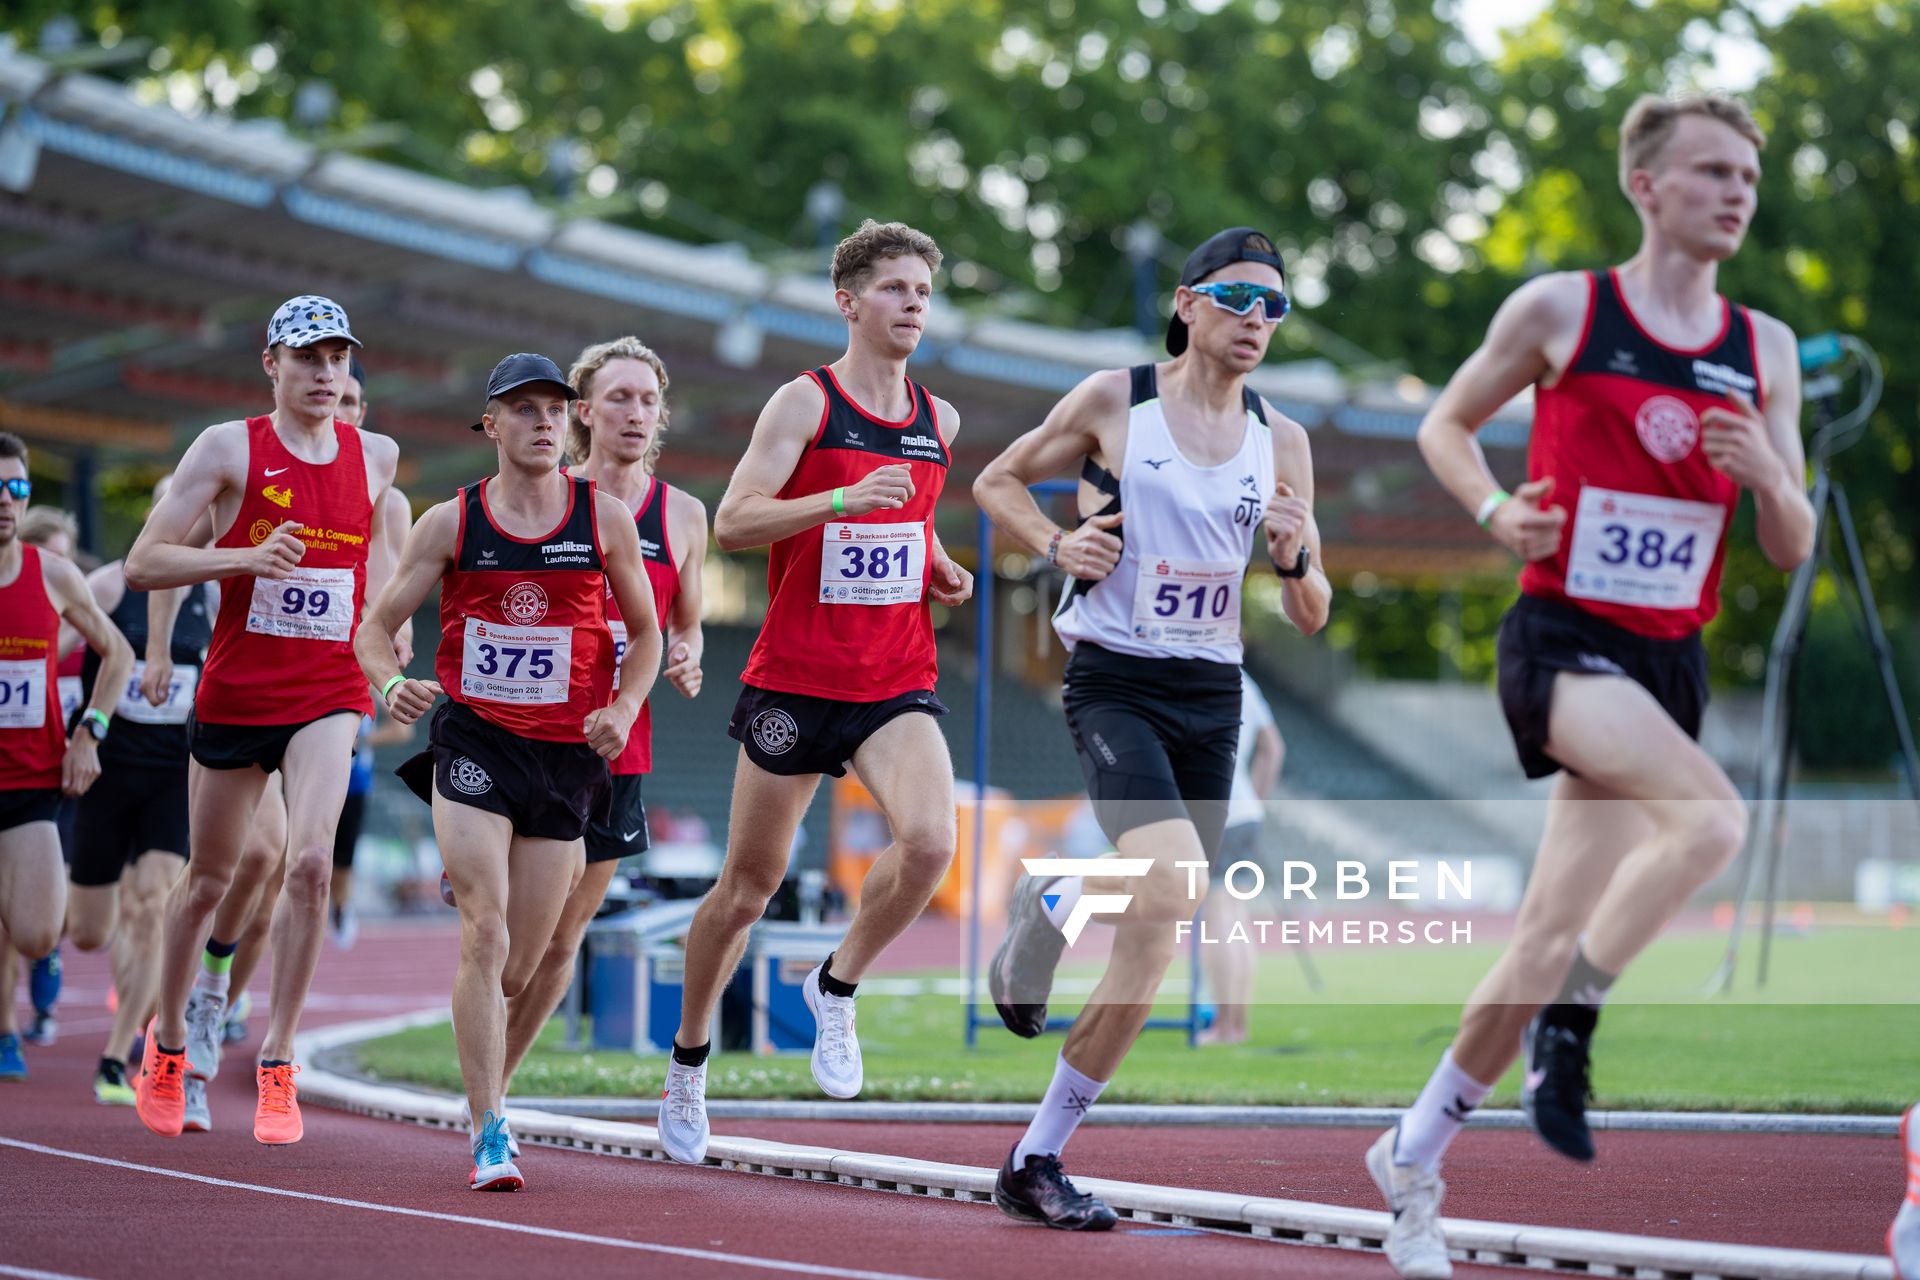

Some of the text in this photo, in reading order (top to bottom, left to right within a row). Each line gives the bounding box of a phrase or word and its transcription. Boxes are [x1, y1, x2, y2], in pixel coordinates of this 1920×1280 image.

[902, 448, 940, 460] Laufanalyse
[317, 528, 325, 537] &
[1598, 523, 1697, 572] 384
[545, 555, 590, 565] Laufanalyse
[840, 545, 908, 579] 381
[288, 575, 319, 584] parkasse
[851, 586, 904, 596] Göttingen 2021
[281, 587, 330, 617] 99
[1154, 584, 1230, 619] 510
[277, 620, 312, 631] Göttingen
[489, 632, 523, 641] Sparkasse
[525, 635, 560, 643] Göttingen
[476, 644, 553, 679] 375
[126, 678, 182, 705] 87
[487, 683, 523, 694] Göttingen
